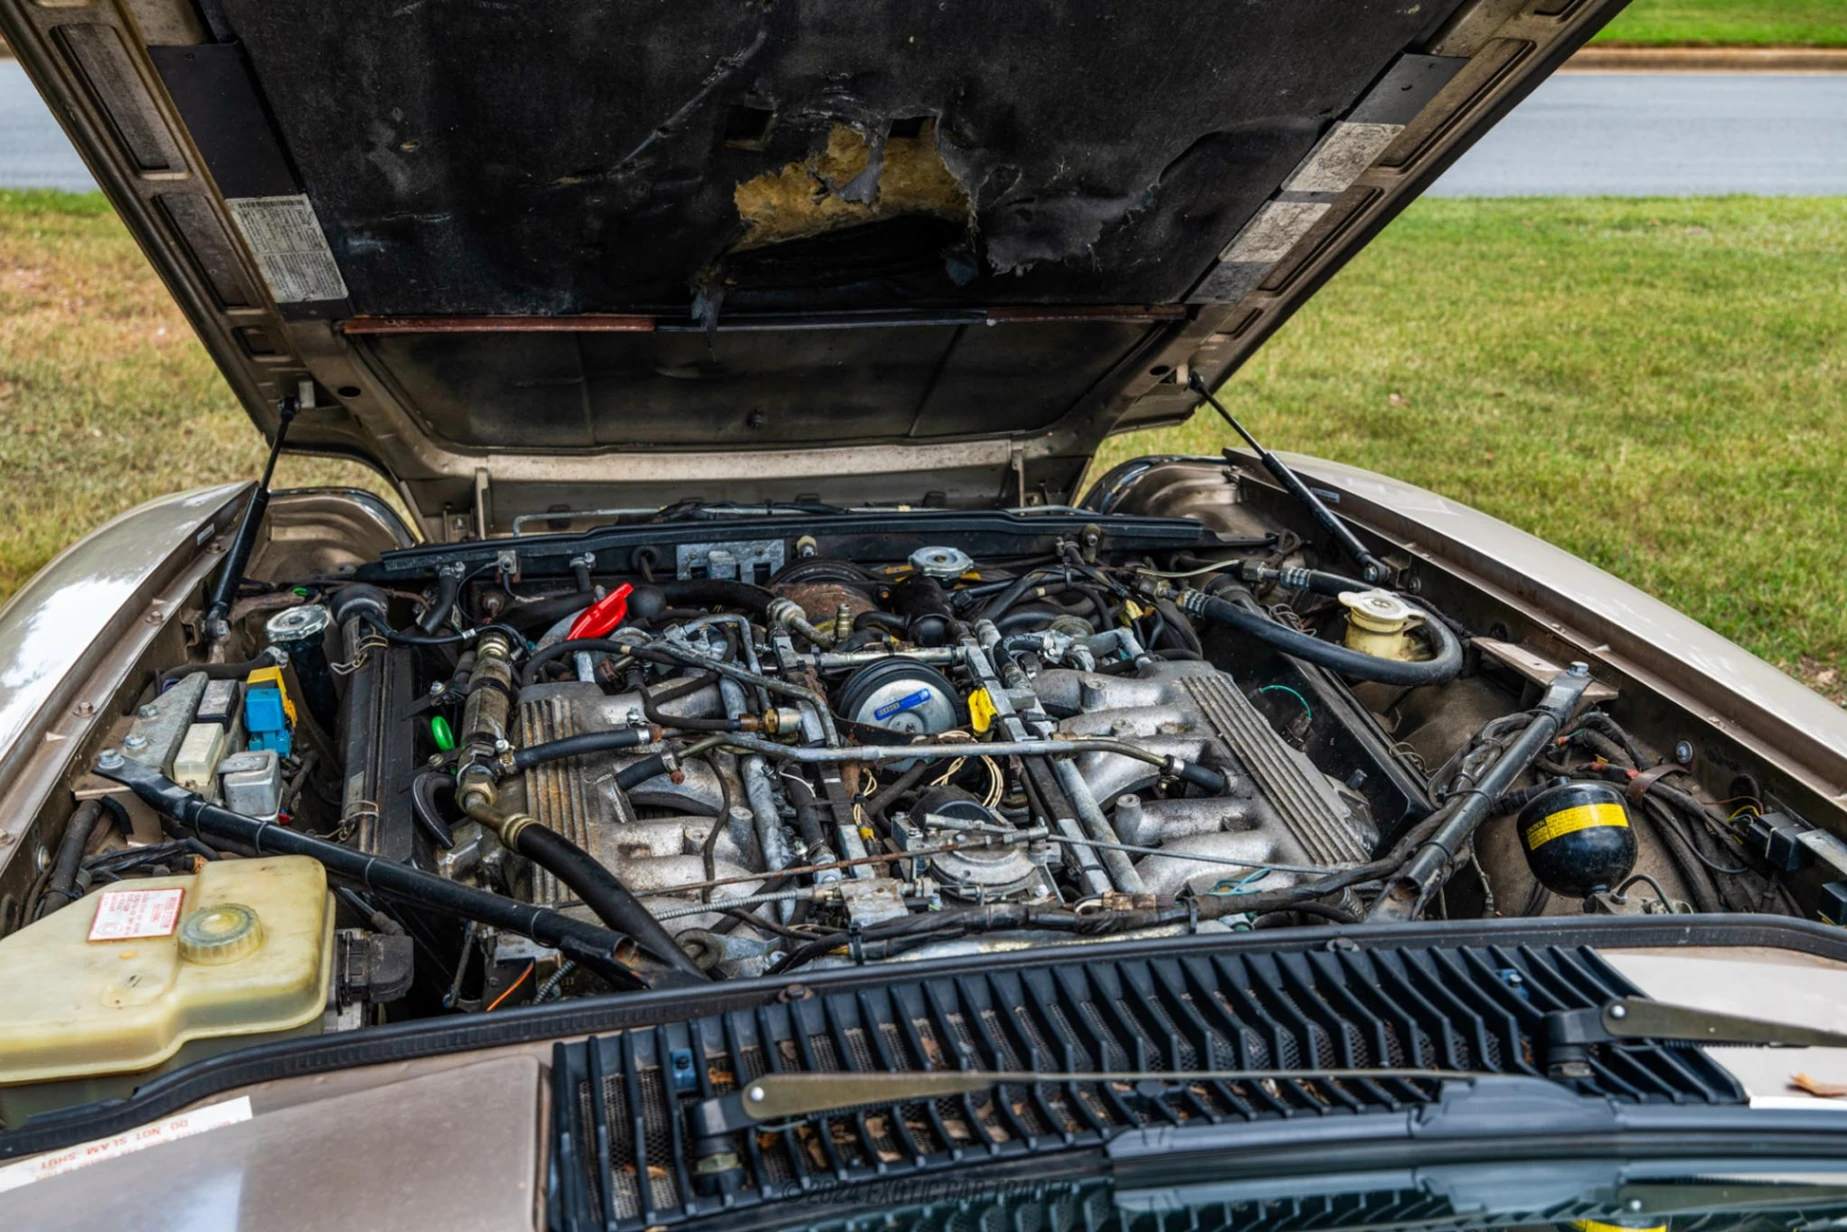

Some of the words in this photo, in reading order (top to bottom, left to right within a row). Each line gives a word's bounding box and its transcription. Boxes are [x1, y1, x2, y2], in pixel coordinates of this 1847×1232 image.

[170, 1119, 188, 1130] DO
[136, 1127, 160, 1140] NOT
[87, 1137, 127, 1154] SLAM
[42, 1153, 76, 1169] SHUT
